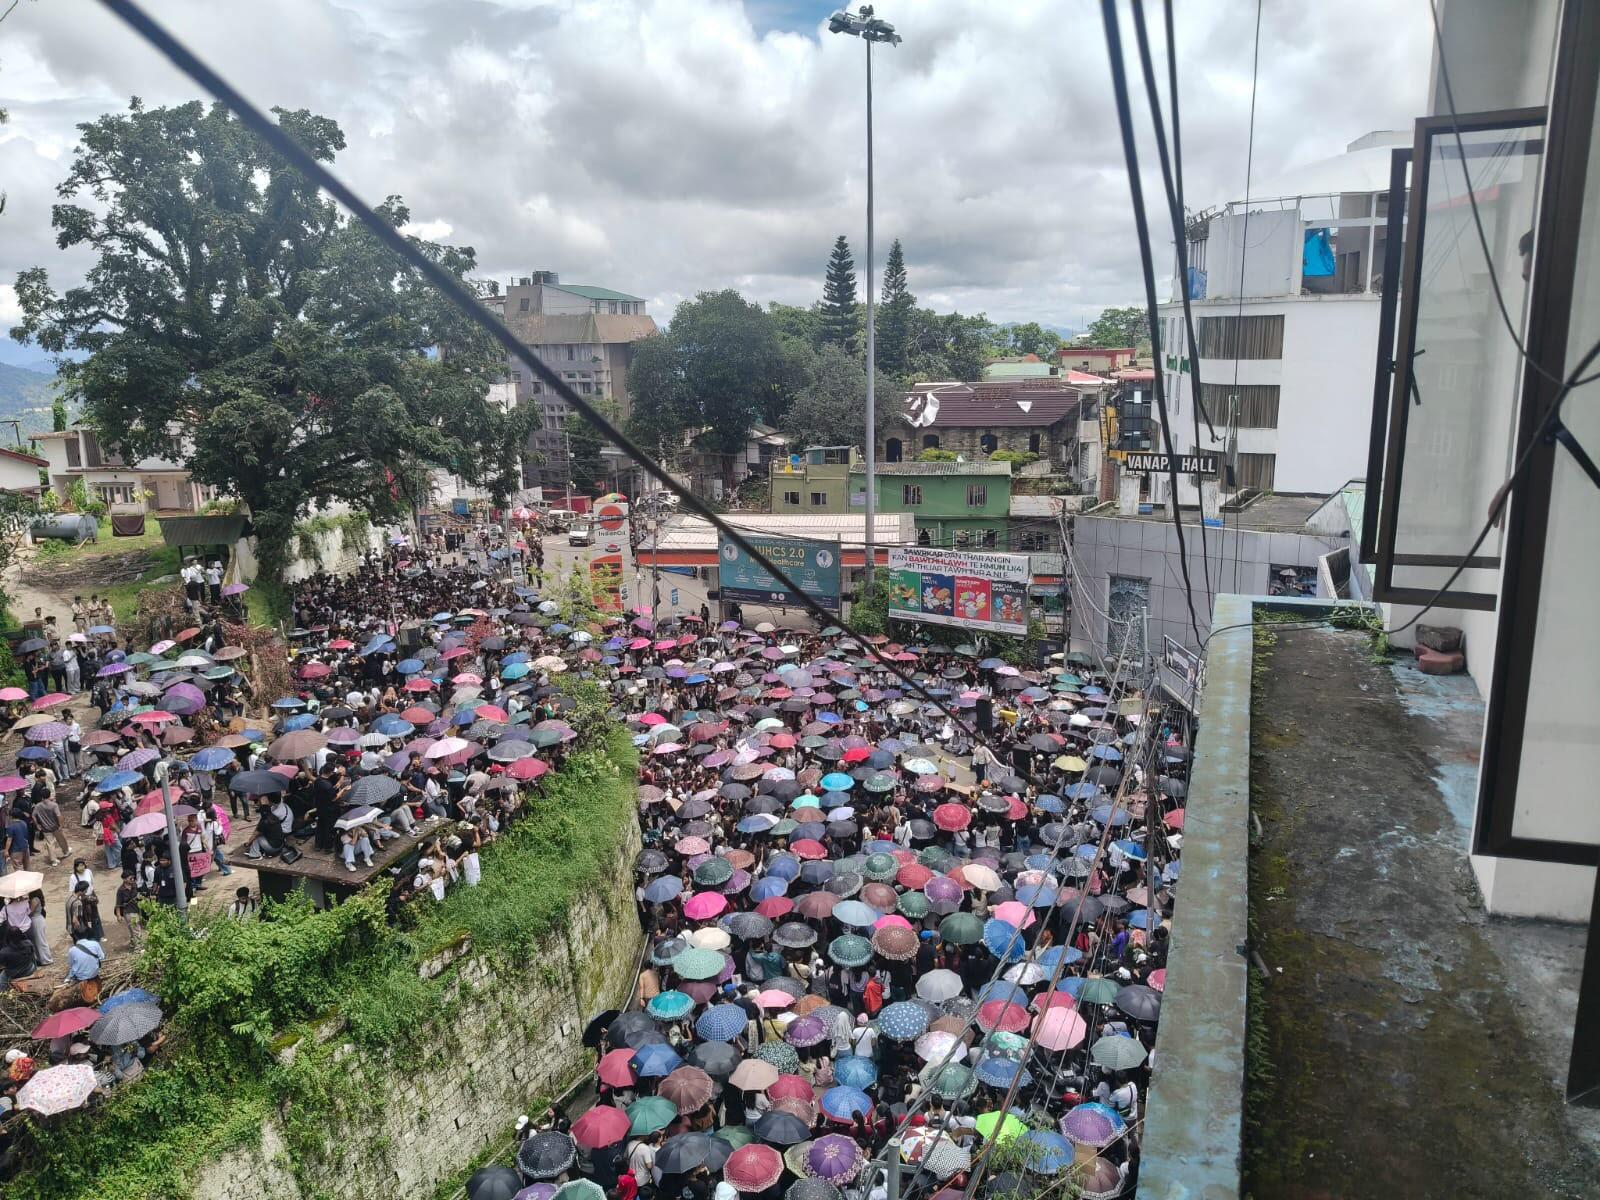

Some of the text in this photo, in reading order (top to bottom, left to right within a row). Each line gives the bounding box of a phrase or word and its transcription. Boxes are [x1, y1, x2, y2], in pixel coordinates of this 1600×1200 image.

[1128, 455, 1216, 473] VANAP HALL
[789, 548, 805, 558] 2.0
[962, 553, 984, 562] THAR
[985, 556, 1011, 564] ANGIN
